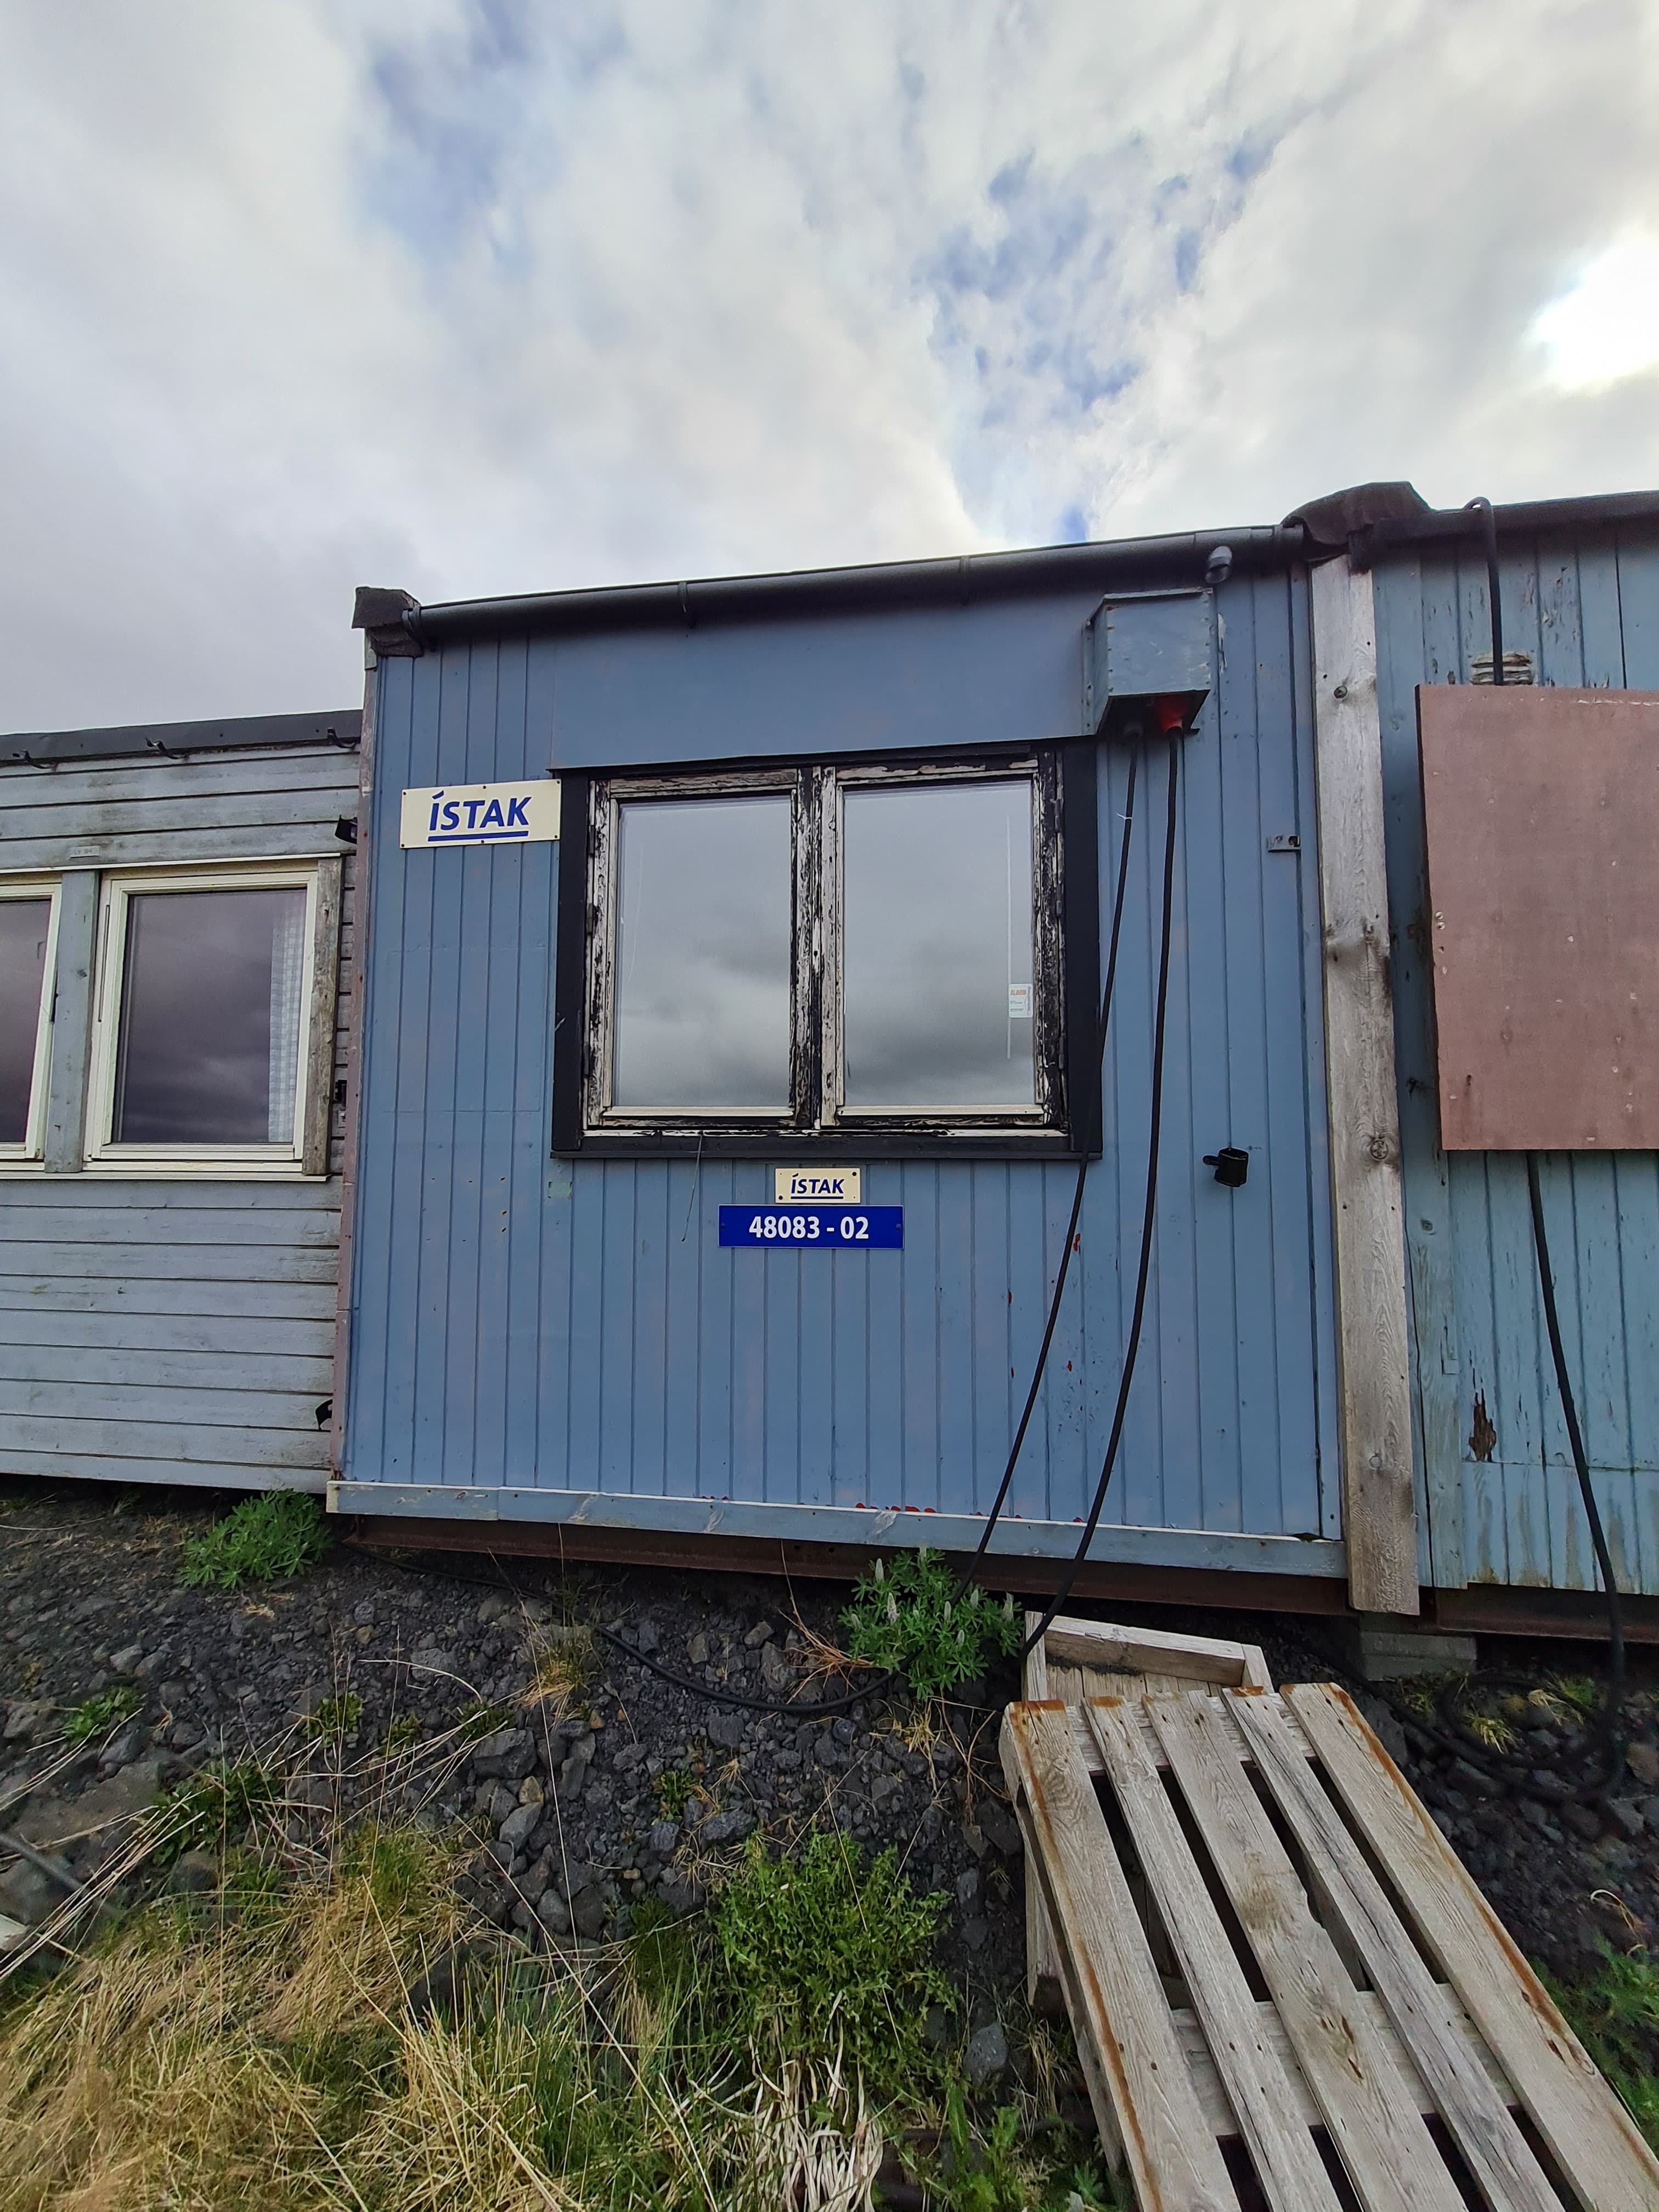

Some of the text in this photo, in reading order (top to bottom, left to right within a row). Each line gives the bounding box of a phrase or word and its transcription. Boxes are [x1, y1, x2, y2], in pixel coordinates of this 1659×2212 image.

[429, 790, 532, 831] ÍSTAK
[791, 1172, 845, 1194] ÍSTAK
[748, 1215, 820, 1239] 48083
[840, 1216, 870, 1239] 02
